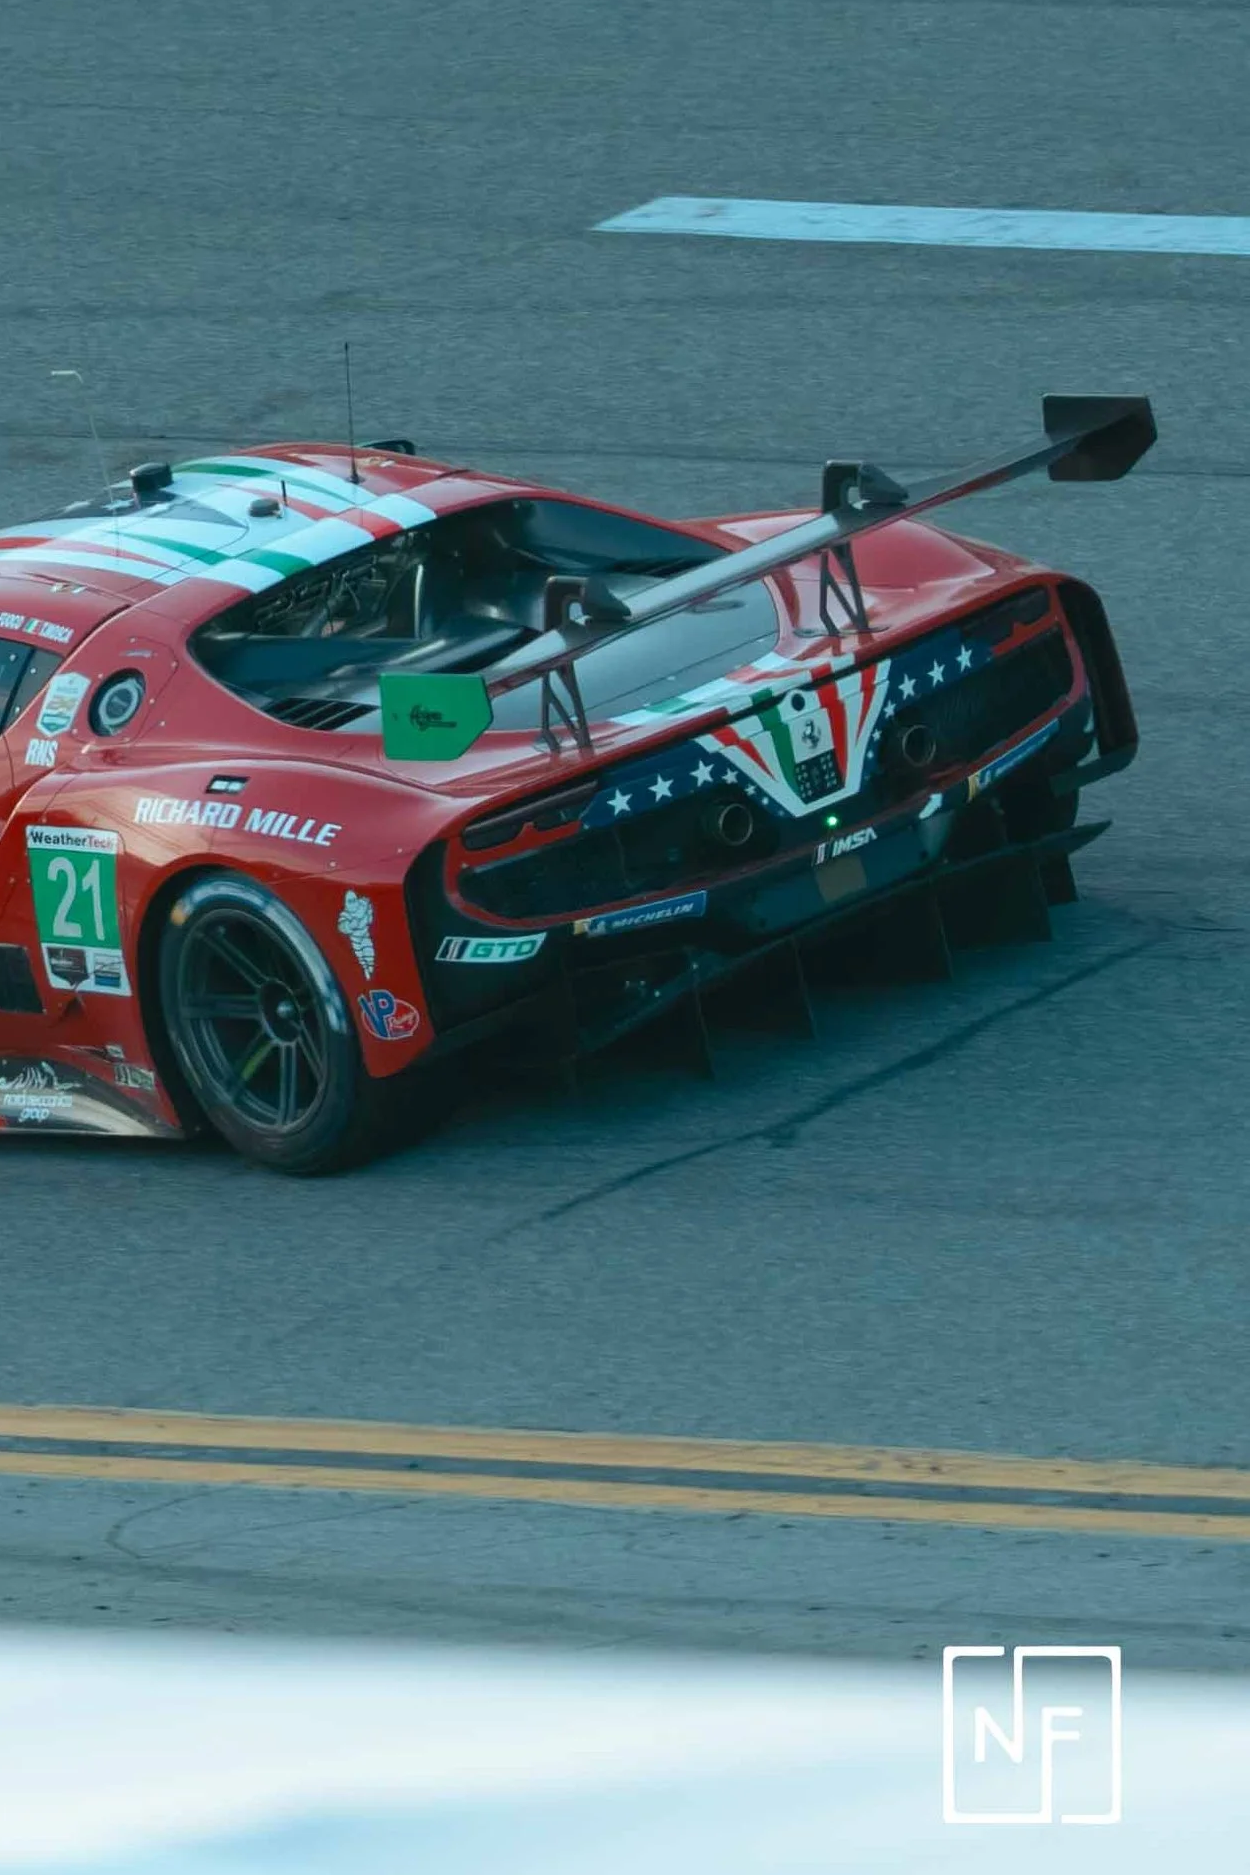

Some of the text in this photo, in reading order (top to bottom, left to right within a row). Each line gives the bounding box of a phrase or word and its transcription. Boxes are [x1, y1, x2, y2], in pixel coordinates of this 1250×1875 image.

[134, 797, 343, 846] RICHARD MILLE
[29, 830, 114, 849] WeatherTech
[831, 827, 878, 857] IMSA
[47, 856, 106, 942] 21
[612, 903, 694, 928] MICHELIN
[469, 939, 538, 959] GTD
